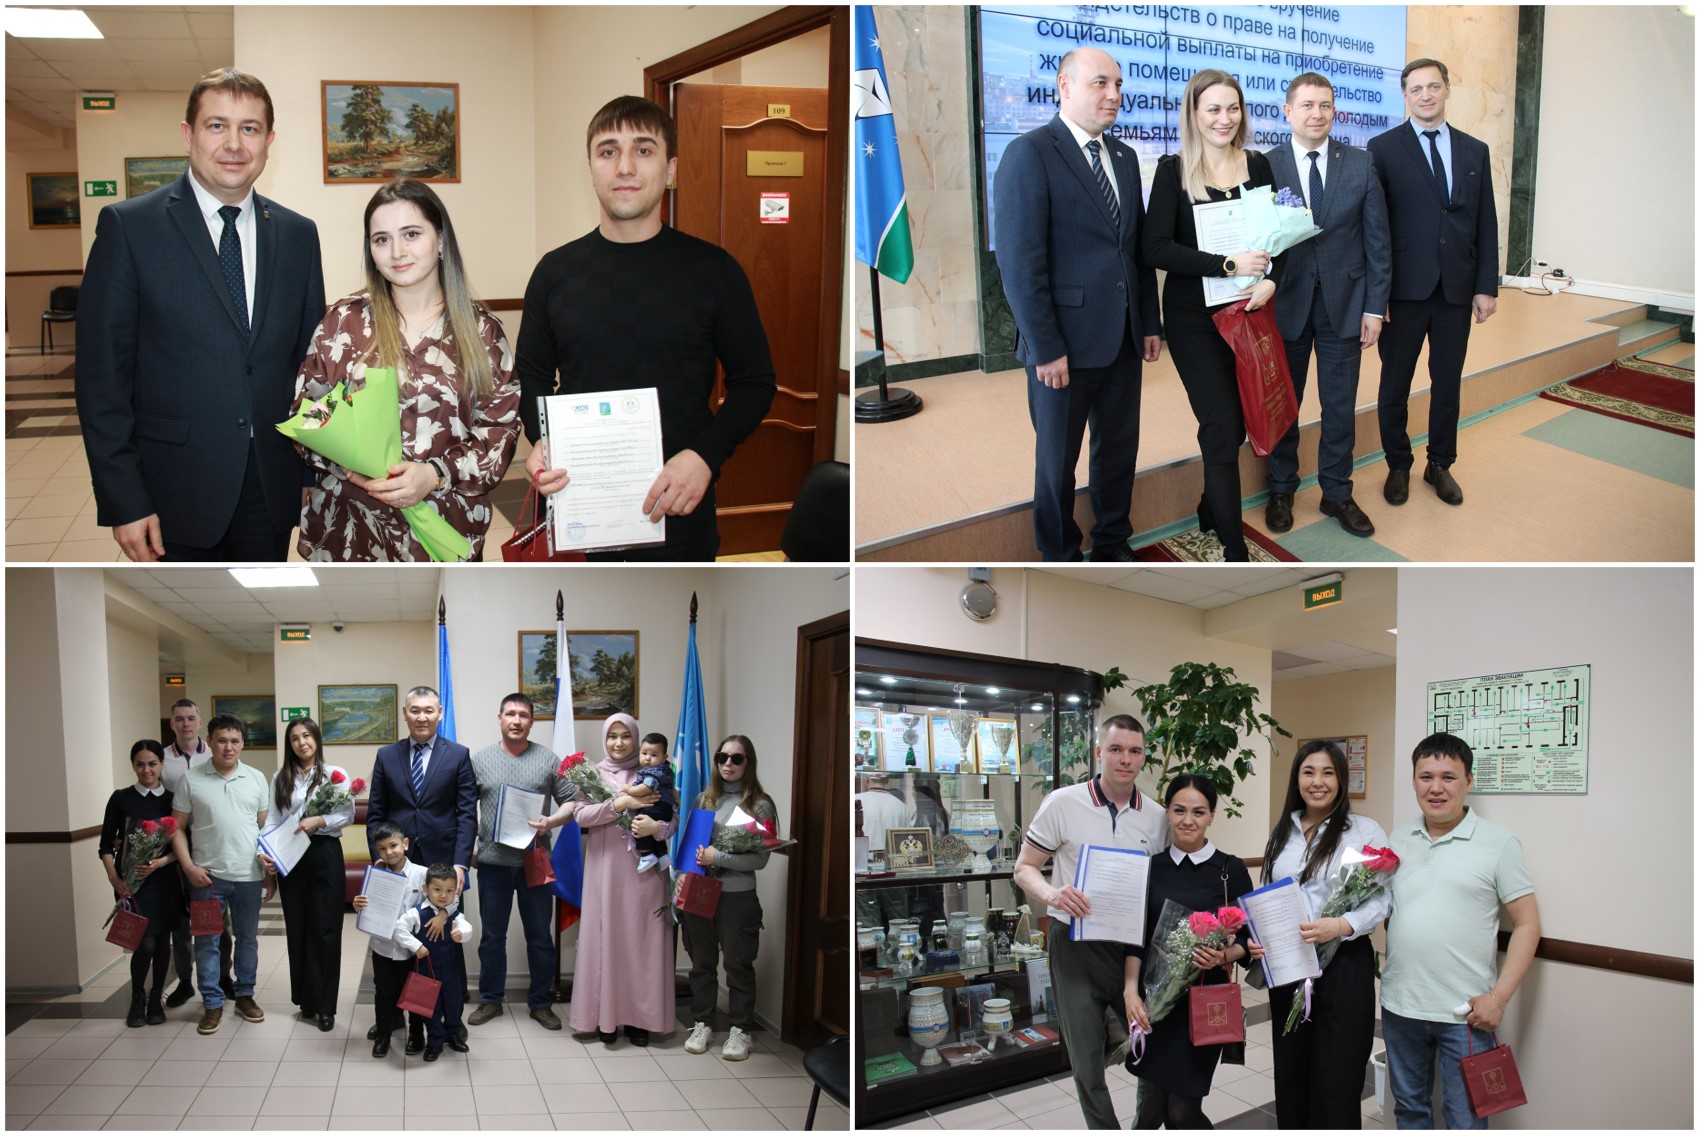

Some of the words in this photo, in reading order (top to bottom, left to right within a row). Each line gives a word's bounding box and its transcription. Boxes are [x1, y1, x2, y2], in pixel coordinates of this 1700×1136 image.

[1206, 12, 1217, 27] о
[1223, 14, 1273, 36] праве
[1278, 25, 1296, 40] на
[1302, 29, 1375, 54] получение
[1036, 19, 1170, 50] социальной
[1177, 38, 1256, 61] выплаты
[1262, 50, 1280, 65] на
[1285, 53, 1384, 80] приобретение
[1246, 75, 1275, 91] или
[772, 107, 786, 115] 109
[1107, 124, 1177, 141] емьям
[1312, 589, 1335, 601] ВЫХОД
